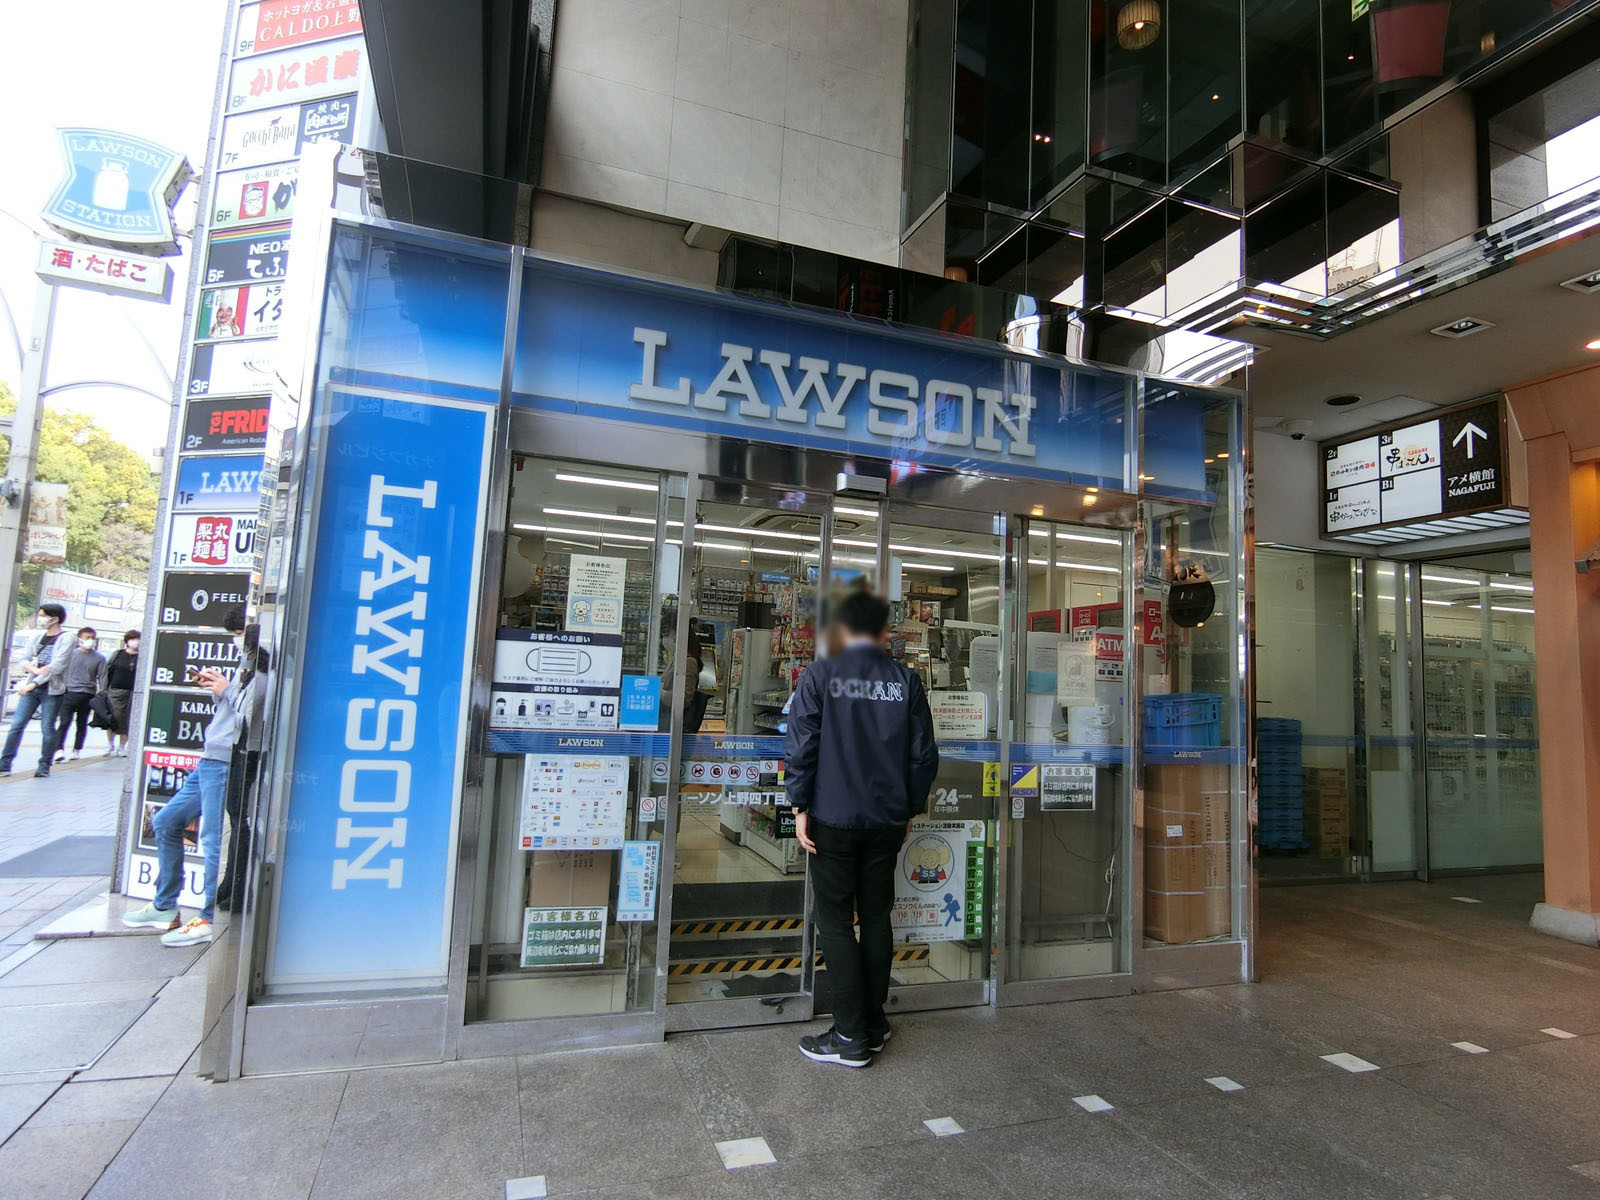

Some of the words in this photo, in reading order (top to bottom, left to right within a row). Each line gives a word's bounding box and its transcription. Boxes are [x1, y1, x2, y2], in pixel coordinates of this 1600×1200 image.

[239, 40, 254, 52] 9F
[71, 139, 163, 168] LAWSON
[225, 152, 239, 165] 7F
[61, 200, 152, 227] STATION
[216, 211, 231, 222] 6F
[51, 248, 148, 282] 酒・たばこ
[208, 269, 224, 282] 5F
[190, 380, 208, 393] 3F
[630, 326, 1037, 457] LAWSON
[186, 435, 203, 448] 2F
[1381, 435, 1392, 444] 3F
[1327, 449, 1338, 458] 2F
[201, 470, 264, 493] LAW
[1448, 468, 1495, 487] アメ横館
[1382, 481, 1393, 489] B1
[1448, 481, 1495, 497] NAGAFUJI
[179, 491, 193, 504] 1F
[1329, 492, 1338, 500] 1F
[173, 552, 187, 564] 1F
[163, 608, 180, 622] B1
[529, 632, 591, 643] お客様へのお願い
[1097, 638, 1123, 651] ATM
[156, 668, 173, 682] B2
[331, 474, 438, 891] LAWSON
[150, 728, 167, 743] B2
[558, 738, 604, 748] LAWSON
[714, 741, 754, 750] LAWSON
[936, 788, 959, 805] 24
[922, 869, 936, 878] SS
[533, 910, 600, 922] お客様各位
[528, 929, 601, 941] ゴミ箱は店内にあります
